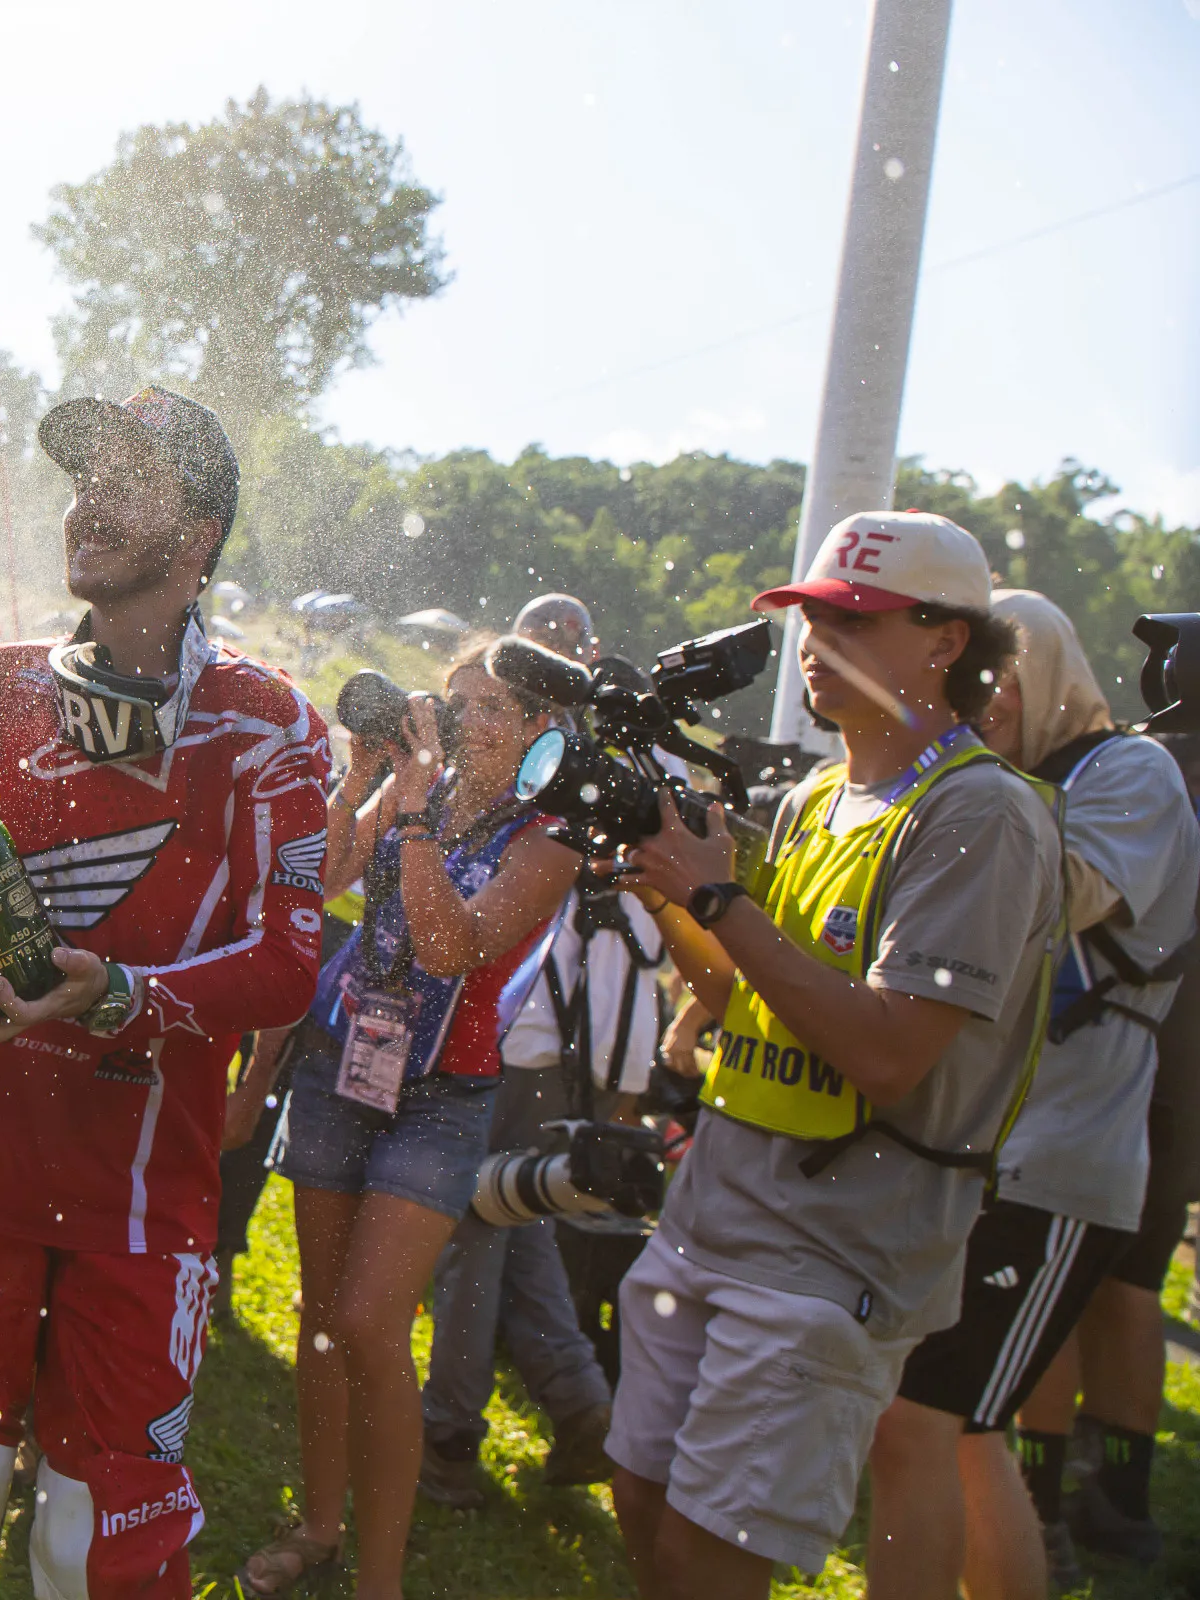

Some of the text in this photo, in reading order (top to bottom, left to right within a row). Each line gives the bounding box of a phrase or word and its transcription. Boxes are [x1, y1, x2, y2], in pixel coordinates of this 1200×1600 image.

[10, 927, 31, 943] 450
[926, 956, 998, 985] SUZUKI
[14, 1037, 91, 1062] DUNLOP
[761, 1041, 844, 1097] ROW
[102, 1482, 200, 1537] Insta360
